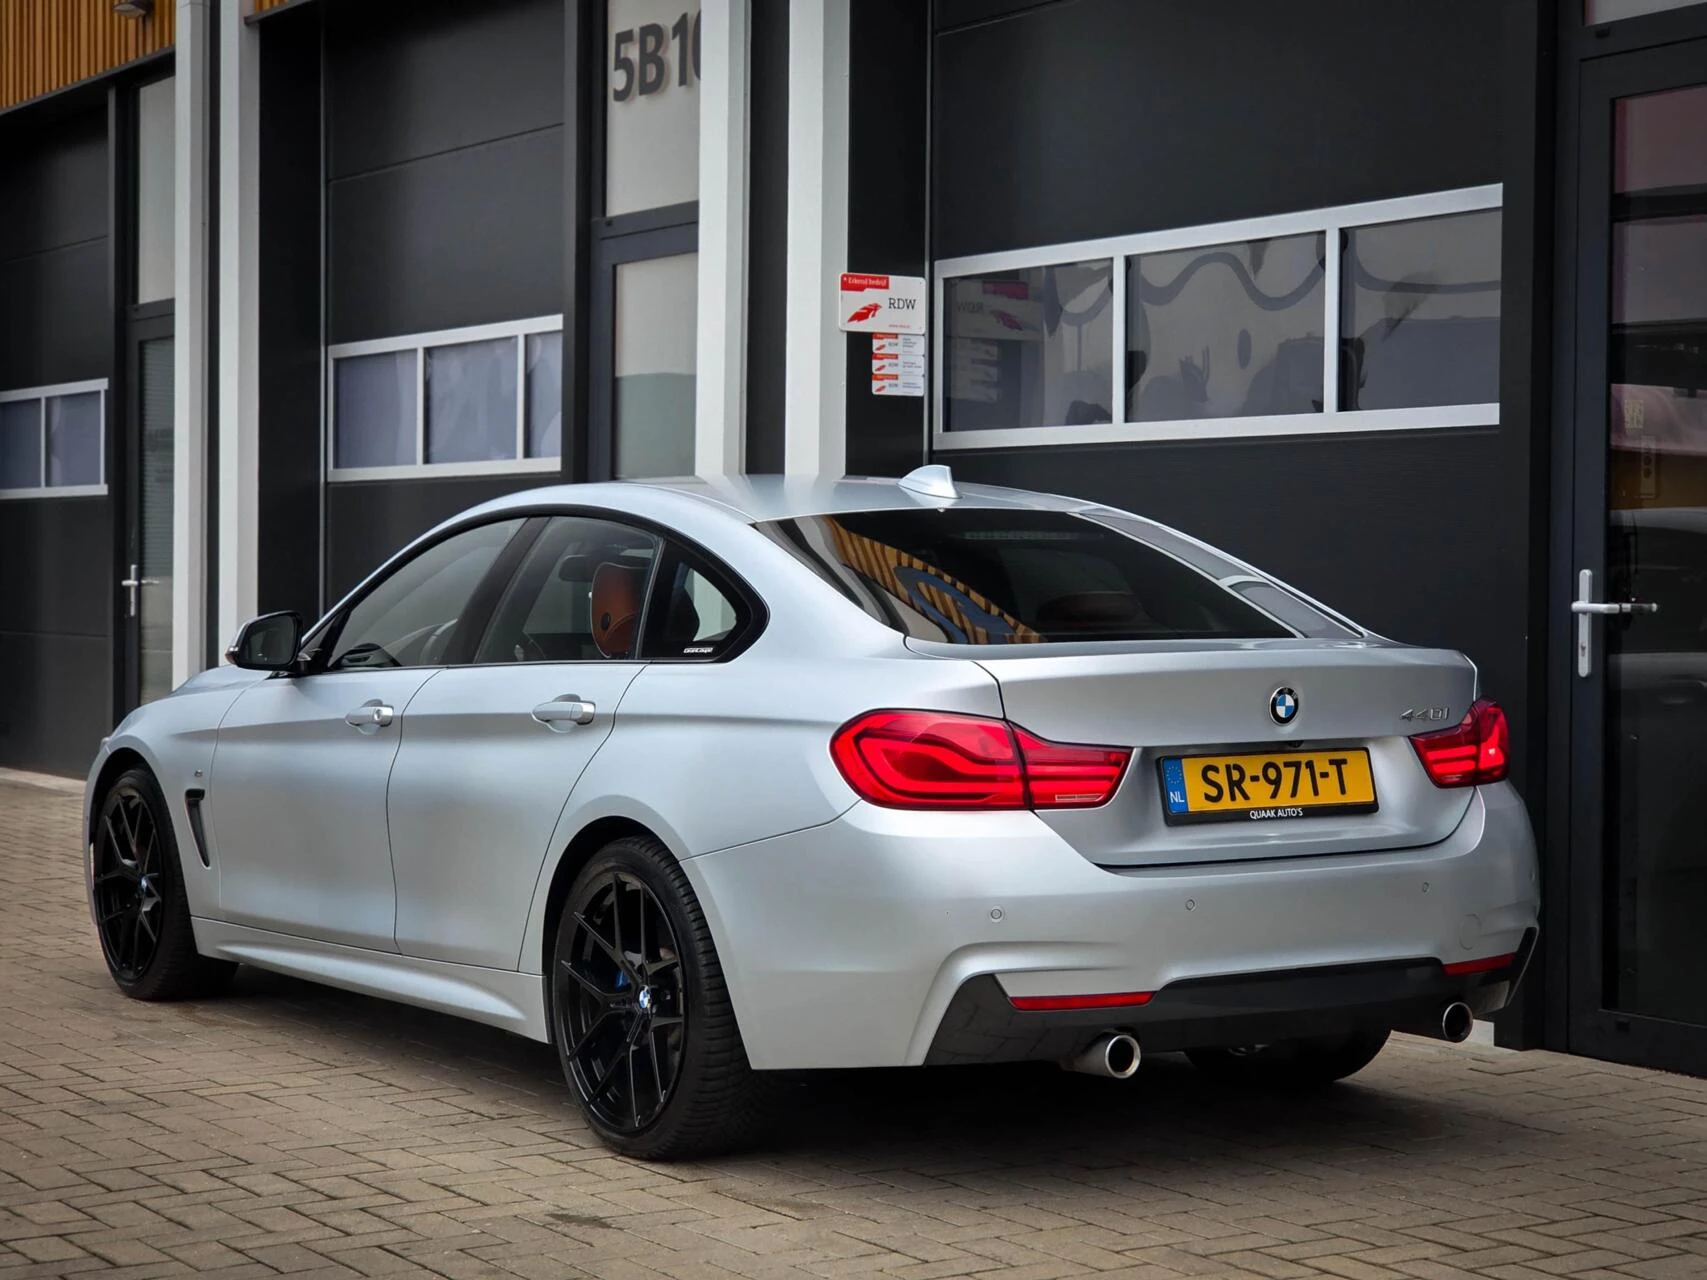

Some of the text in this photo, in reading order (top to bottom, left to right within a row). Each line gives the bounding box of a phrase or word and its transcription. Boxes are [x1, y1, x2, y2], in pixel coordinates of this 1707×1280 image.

[888, 297, 916, 310] RDW
[1201, 758, 1348, 803] SR-971-T
[1169, 791, 1185, 803] NL
[1250, 808, 1303, 819] QUAAK AUTO'S
